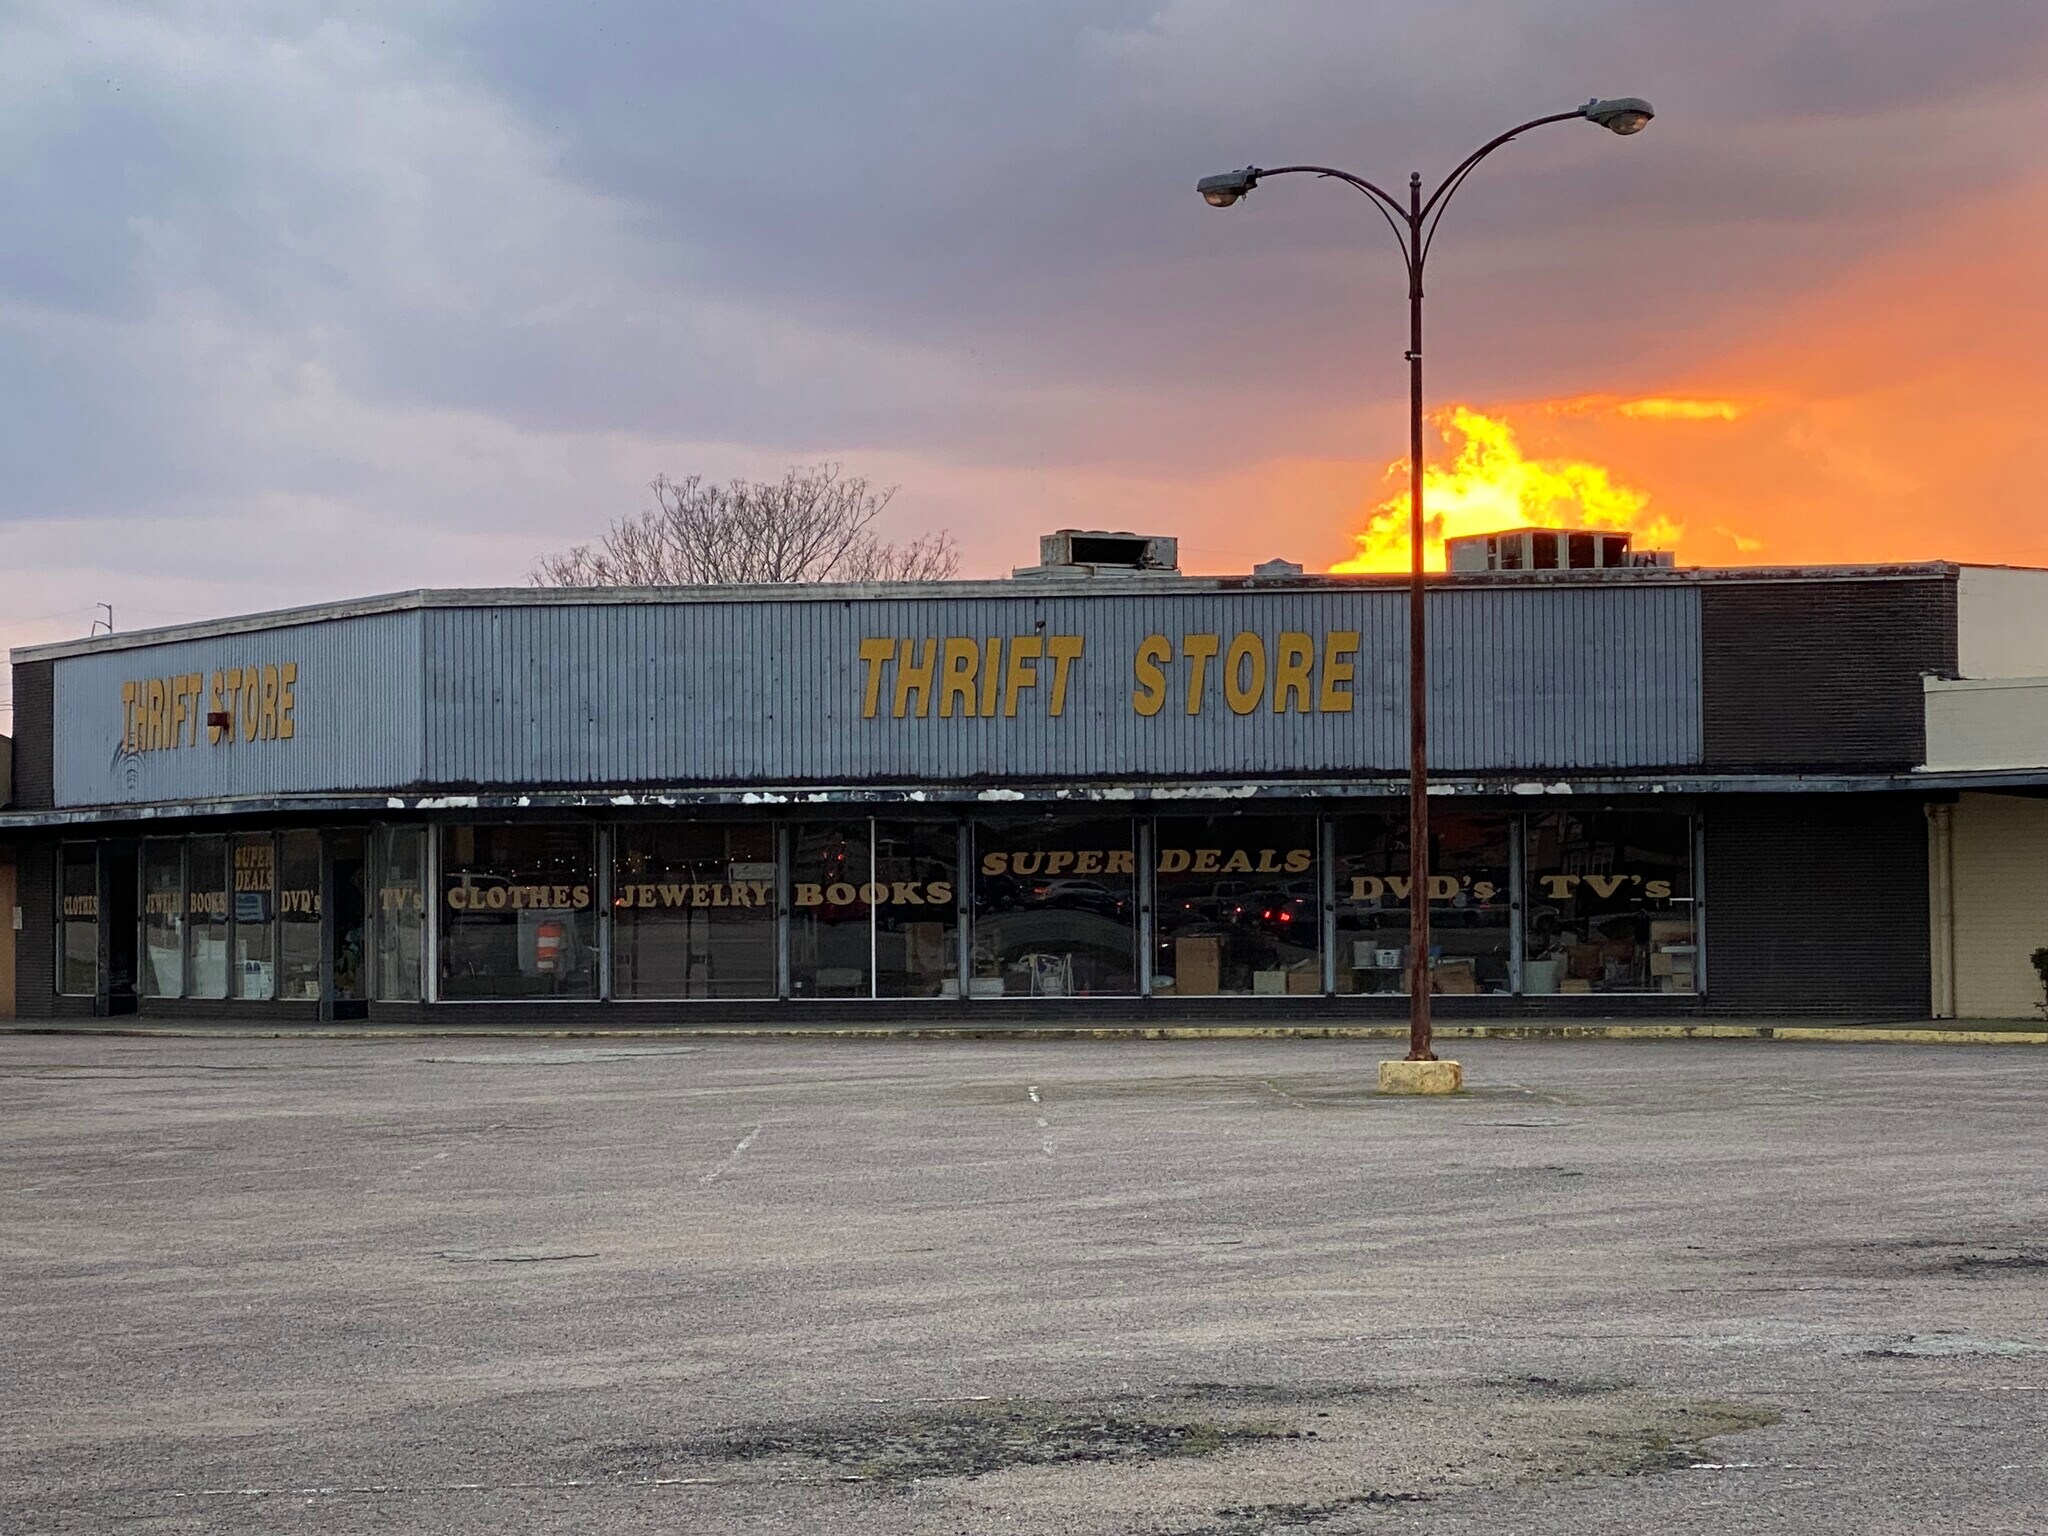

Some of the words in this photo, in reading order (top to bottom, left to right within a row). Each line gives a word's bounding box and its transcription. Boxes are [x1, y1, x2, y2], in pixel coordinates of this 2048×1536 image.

[860, 635, 1084, 719] THRIFT
[1132, 631, 1361, 717] STORE
[122, 672, 203, 753] THRIFT
[208, 663, 297, 746] STORE
[234, 846, 273, 868] SUPER
[981, 849, 1134, 876] SUPER
[1157, 849, 1311, 873] DEALS
[235, 869, 273, 892] DEALS
[795, 880, 952, 906] BOOKS
[1540, 874, 1671, 899] TV's
[64, 896, 98, 916] CLOTHES
[190, 891, 228, 913] BOOKS
[280, 889, 321, 914] DVD's
[380, 887, 422, 911] TV's
[447, 885, 590, 910] CLOTHES
[616, 881, 773, 908] JEWELRY
